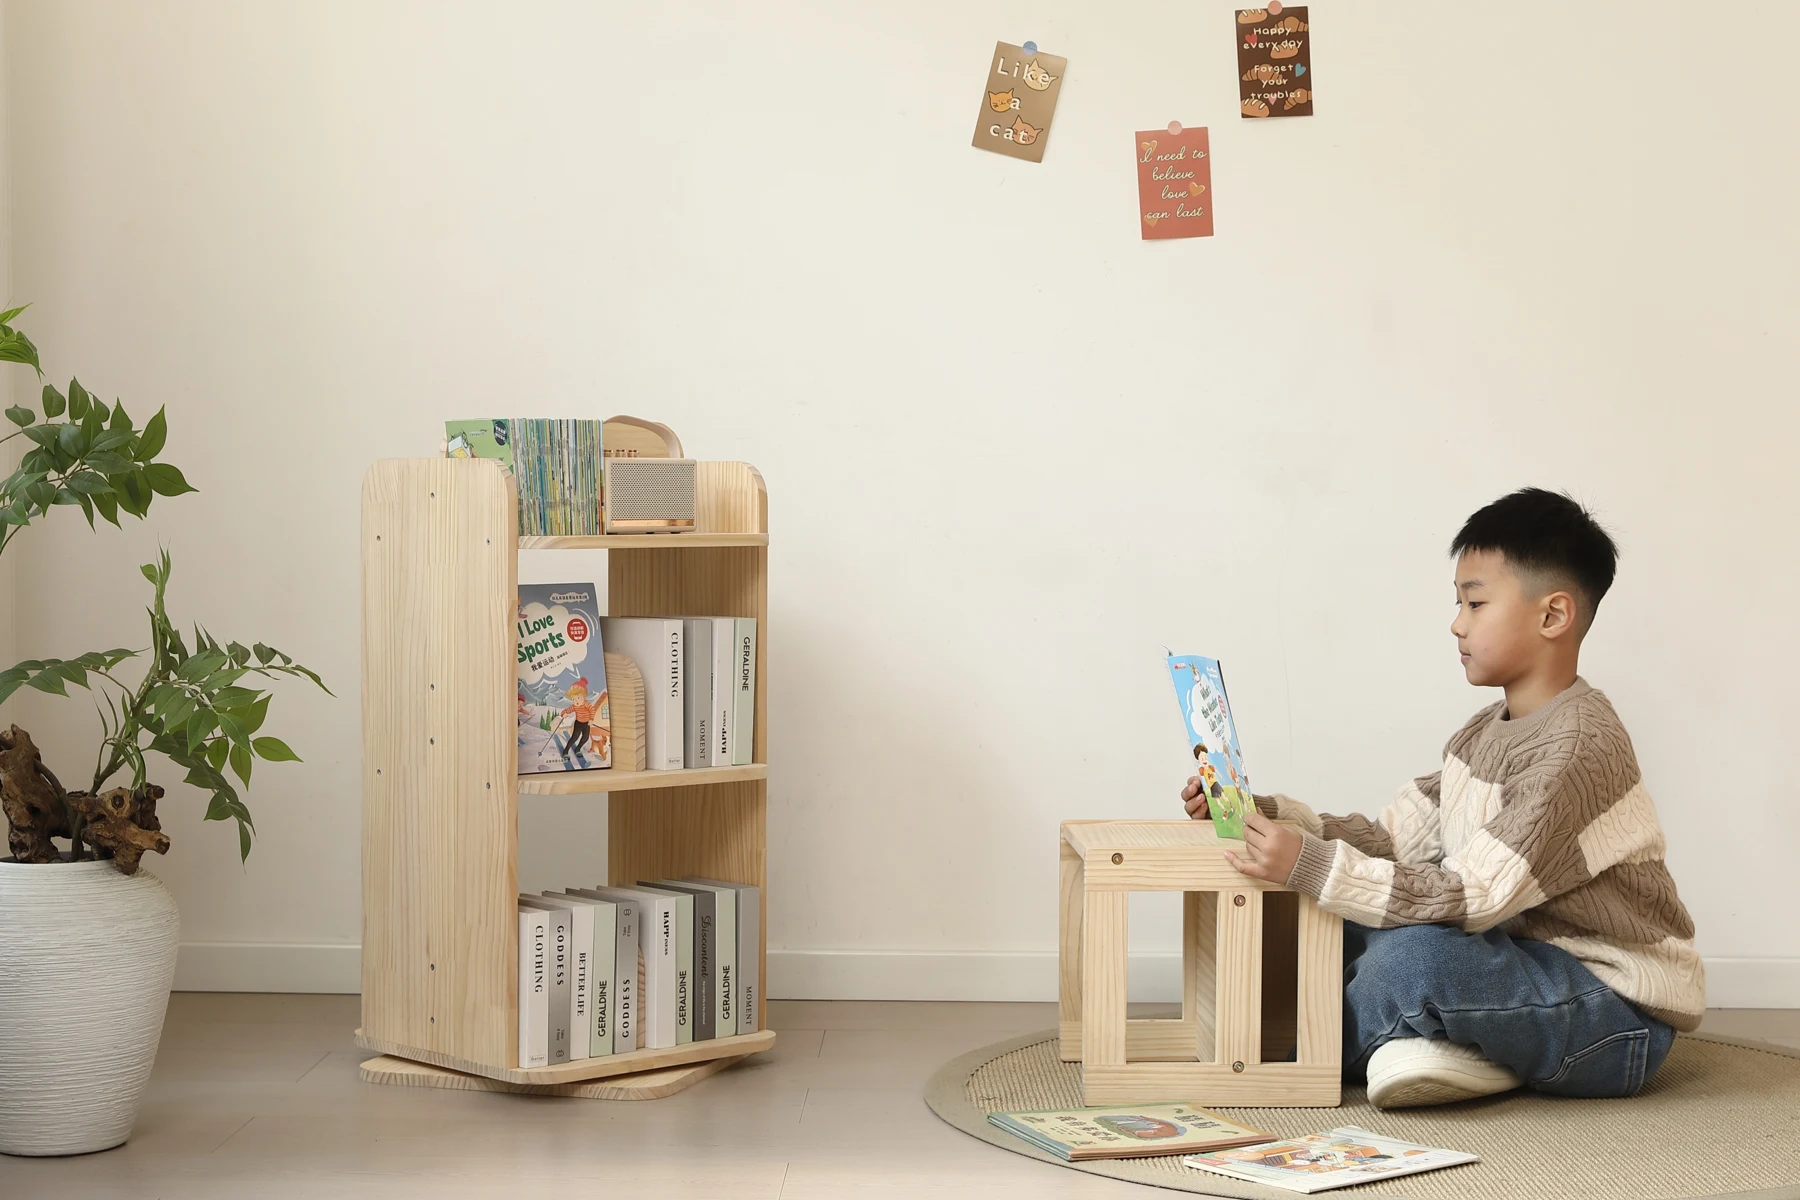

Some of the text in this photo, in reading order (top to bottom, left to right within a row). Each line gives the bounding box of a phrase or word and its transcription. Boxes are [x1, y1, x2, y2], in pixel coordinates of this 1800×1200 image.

[1253, 27, 1292, 36] Happy
[997, 57, 1051, 85] Like
[1254, 64, 1294, 74] Forget
[1261, 78, 1288, 88] your
[1010, 97, 1021, 110] a
[1250, 90, 1301, 100] troubles
[989, 124, 1028, 143] cat
[1140, 145, 1208, 163] I need to
[1152, 165, 1196, 180] believe
[1161, 184, 1189, 200] love
[1145, 211, 1171, 219] can
[518, 621, 525, 638] I
[523, 614, 555, 636] Love
[518, 632, 566, 663] Sports
[671, 632, 679, 698] CLOTHING
[741, 636, 751, 692] GERALDINE
[534, 925, 544, 993] CLOTHING
[556, 925, 565, 986] GODDESS
[701, 915, 712, 979] Discontent
[577, 952, 587, 1017] BETTER LIFE
[678, 970, 687, 1026] GERALDINE
[722, 964, 731, 1020] GERALDINE
[597, 980, 608, 1037] GERALDINE
[622, 979, 631, 1038] GODDESS
